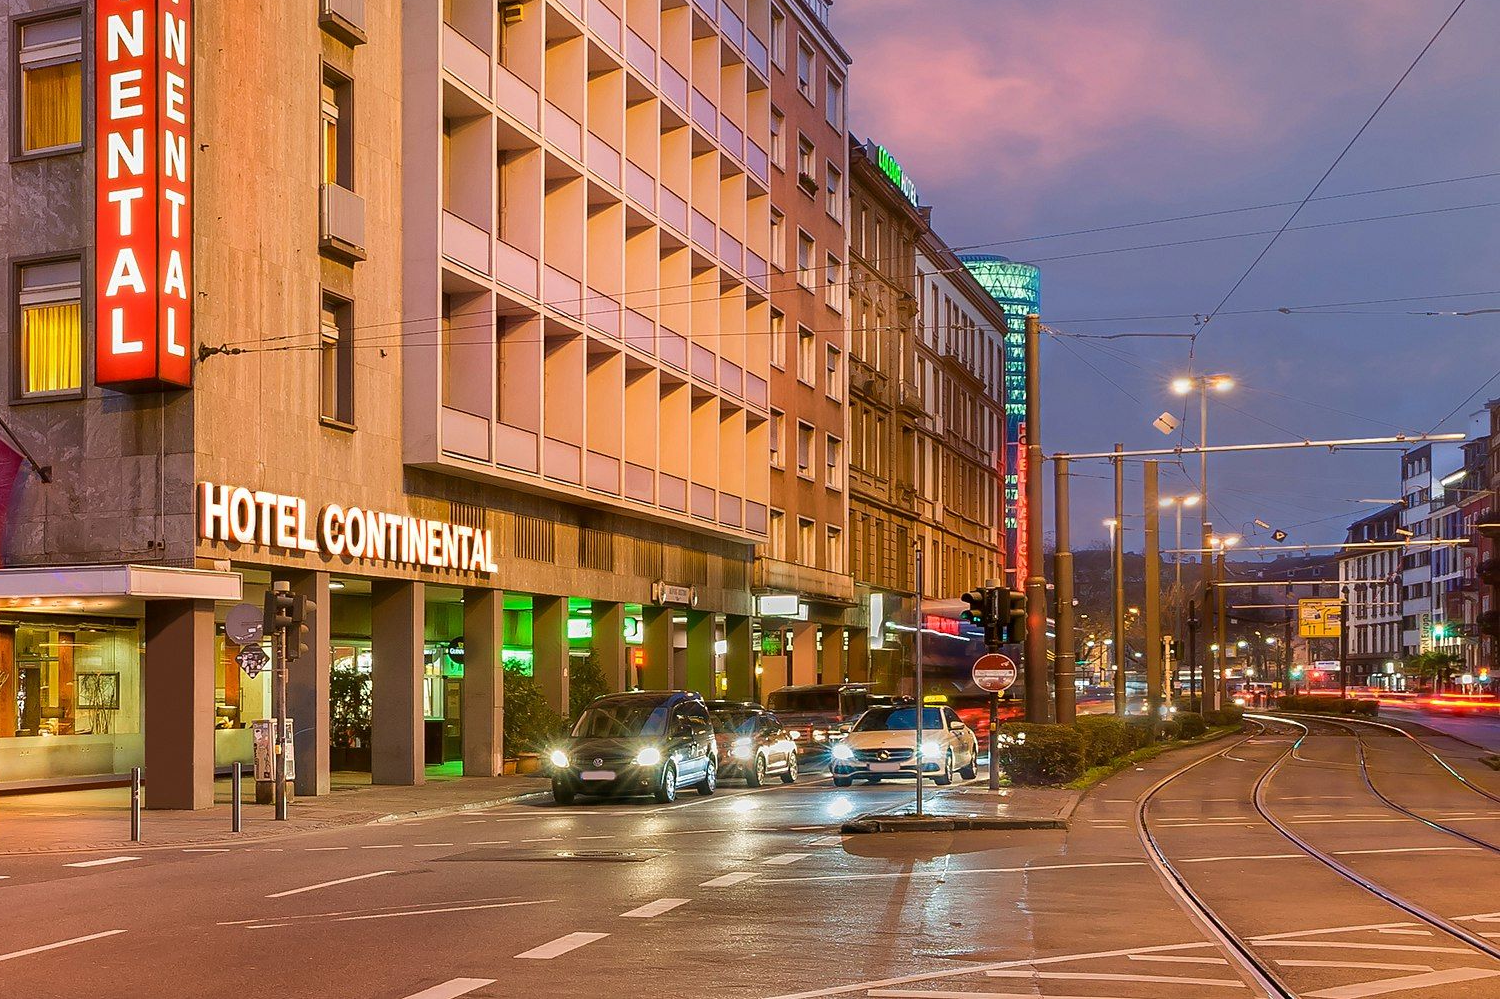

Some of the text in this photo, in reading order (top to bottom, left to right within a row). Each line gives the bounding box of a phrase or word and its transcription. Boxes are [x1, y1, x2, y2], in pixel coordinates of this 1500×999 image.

[1018, 422, 1027, 484] HOTEL
[199, 481, 499, 574] HOTEL CONTINENTAL
